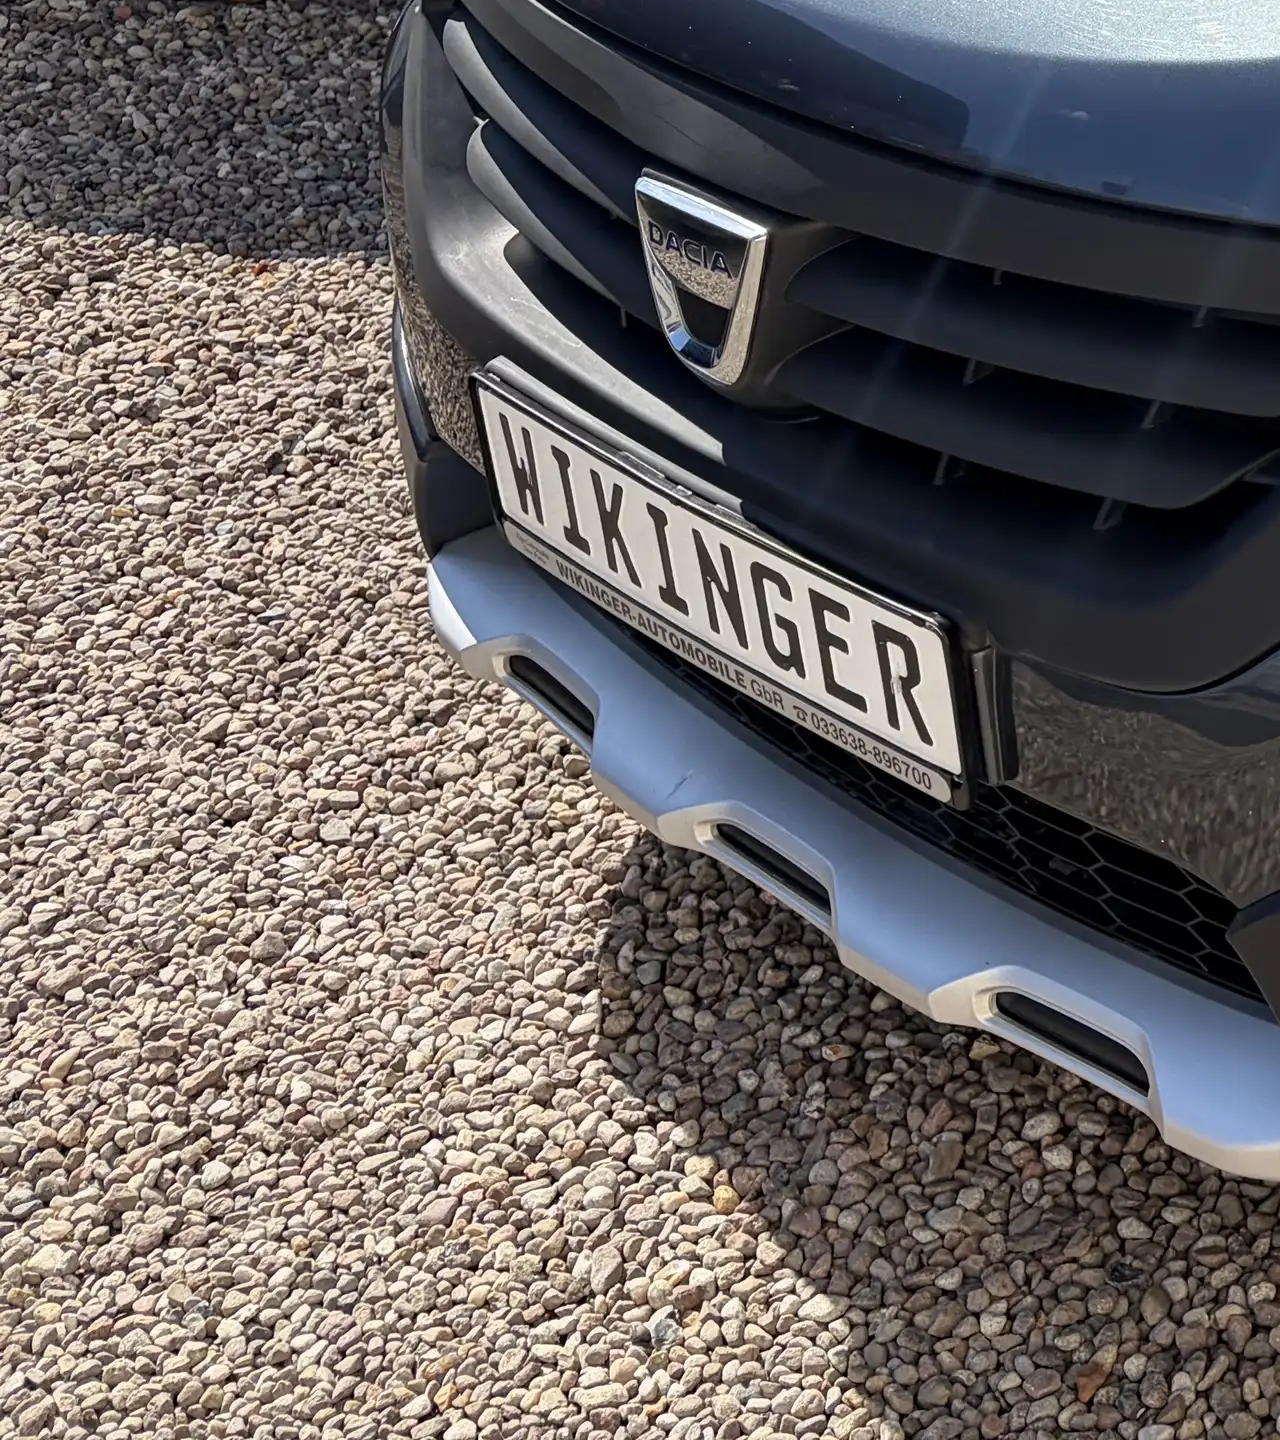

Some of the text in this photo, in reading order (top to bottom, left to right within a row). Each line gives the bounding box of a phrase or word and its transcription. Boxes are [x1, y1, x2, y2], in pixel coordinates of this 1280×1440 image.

[647, 220, 734, 279] DACIA
[497, 411, 934, 748] WIKINGER
[555, 559, 748, 690] WIKINGER-AUTOMOBILE
[750, 678, 785, 711] GbR
